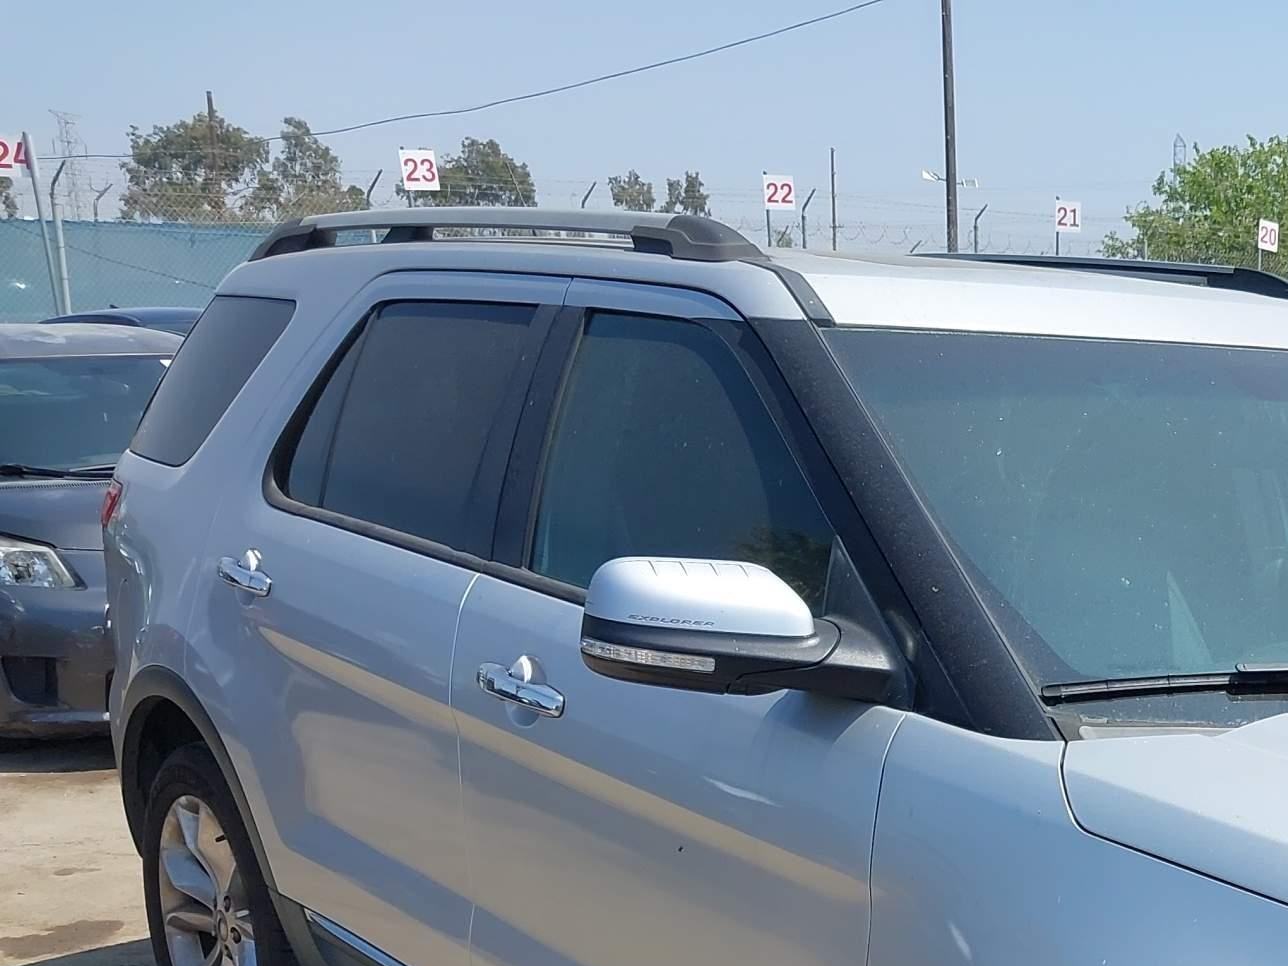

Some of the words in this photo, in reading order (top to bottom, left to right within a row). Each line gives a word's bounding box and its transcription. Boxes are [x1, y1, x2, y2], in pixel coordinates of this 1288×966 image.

[403, 158, 436, 182] 23
[766, 182, 793, 203] 22
[1057, 206, 1080, 227] 21
[1260, 226, 1277, 246] 20
[627, 613, 715, 627] EXPLORER
